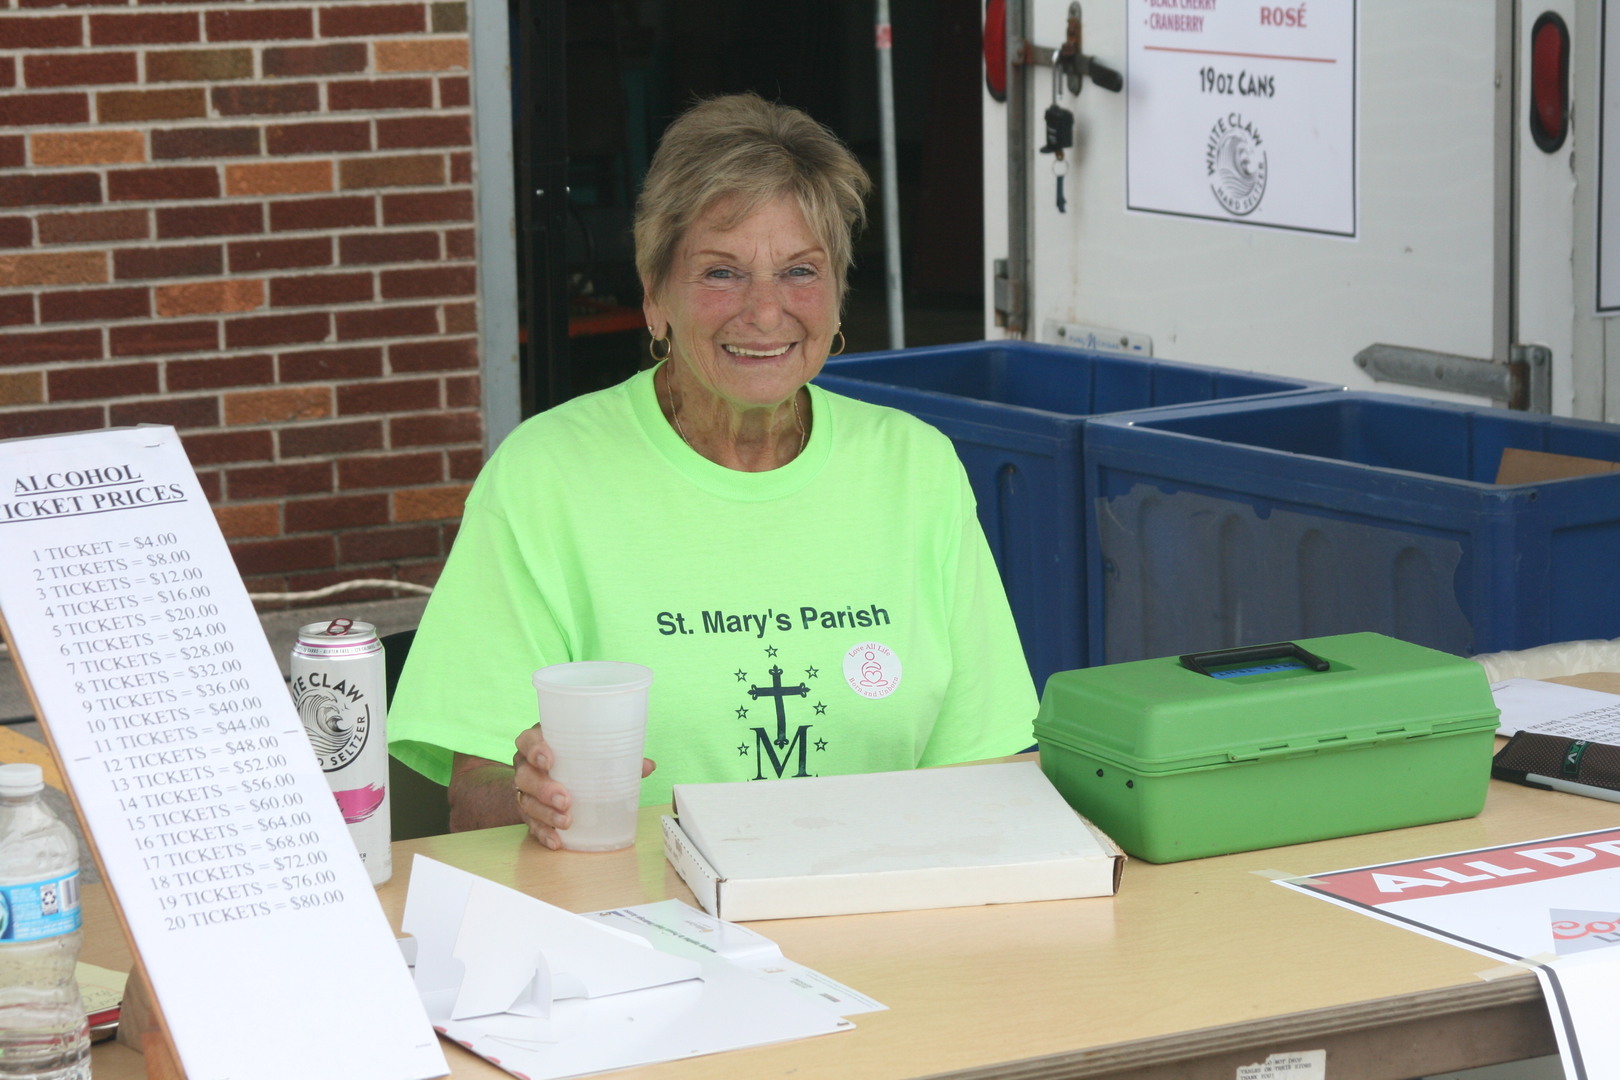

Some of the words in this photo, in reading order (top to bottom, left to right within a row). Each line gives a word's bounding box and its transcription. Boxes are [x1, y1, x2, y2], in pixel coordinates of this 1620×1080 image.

[1150, 12, 1204, 32] CRANBERRY
[1260, 3, 1307, 28] ROSÉ
[1206, 117, 1226, 176] WHITE
[1228, 112, 1263, 147] CLAW
[14, 464, 142, 493] ALCOHOL
[0, 495, 83, 520] ICKET
[91, 483, 185, 510] PRICES
[32, 549, 40, 562] 1
[44, 540, 113, 560] TICKET
[133, 532, 177, 549] $4.00
[32, 568, 45, 581] 2
[46, 558, 128, 579] TICKETS
[146, 549, 190, 567] $8.00
[35, 587, 46, 600] 3
[49, 576, 131, 598] TICKETS
[149, 566, 202, 585] $12.00
[44, 606, 54, 618] 4
[56, 594, 138, 617] TICKETS
[157, 585, 210, 603] $16.00
[52, 624, 62, 637] 5
[64, 613, 146, 635] TICKETS
[164, 603, 218, 622] $20.00
[656, 611, 694, 636] St.
[702, 609, 792, 638] Mary's
[800, 604, 891, 630] Parish
[59, 643, 70, 656] 6
[72, 632, 154, 654] TICKETS
[172, 621, 226, 641] $24.00
[66, 662, 75, 675] 7
[79, 651, 161, 673] TICKETS
[179, 639, 234, 660] $28.00
[74, 681, 86, 694] 8
[87, 670, 169, 692] TICKETS
[187, 658, 241, 679] $32.00
[309, 672, 364, 703] CLAW
[81, 700, 92, 713] 9
[95, 689, 177, 711] TICKETS
[195, 677, 249, 697] $36.00
[86, 718, 106, 733] 10
[108, 707, 190, 730] TICKETS
[208, 696, 262, 716] $40.00
[93, 738, 112, 753] 11
[115, 726, 198, 749] TICKETS
[216, 715, 270, 735] $44.00
[330, 716, 366, 766] SELTZER
[102, 758, 123, 772] 12
[124, 746, 206, 769] TICKETS
[225, 735, 278, 755] $48.00
[111, 777, 129, 792] 13
[132, 765, 214, 788] TICKETS
[232, 754, 287, 774] $52.00
[118, 797, 138, 811] 14
[140, 784, 222, 808] TICKETS
[241, 772, 295, 793] $56.00
[126, 816, 145, 831] 15
[148, 803, 230, 827] TICKETS
[249, 791, 303, 812] $60.00
[134, 835, 154, 850] 16
[155, 823, 238, 847] TICKETS
[257, 811, 311, 831] $64.00
[142, 855, 159, 870] 17
[164, 842, 246, 866] TICKETS
[265, 830, 319, 851] $68.00
[150, 875, 170, 890] 18
[171, 862, 255, 886] TICKETS
[273, 850, 327, 871] $72.00
[1371, 860, 1538, 893] ALL
[158, 895, 177, 910] 19
[180, 881, 263, 906] TICKETS
[281, 870, 335, 890] $76.00
[164, 915, 186, 931] 20
[188, 901, 271, 926] TICKETS
[289, 889, 344, 910] $80.00
